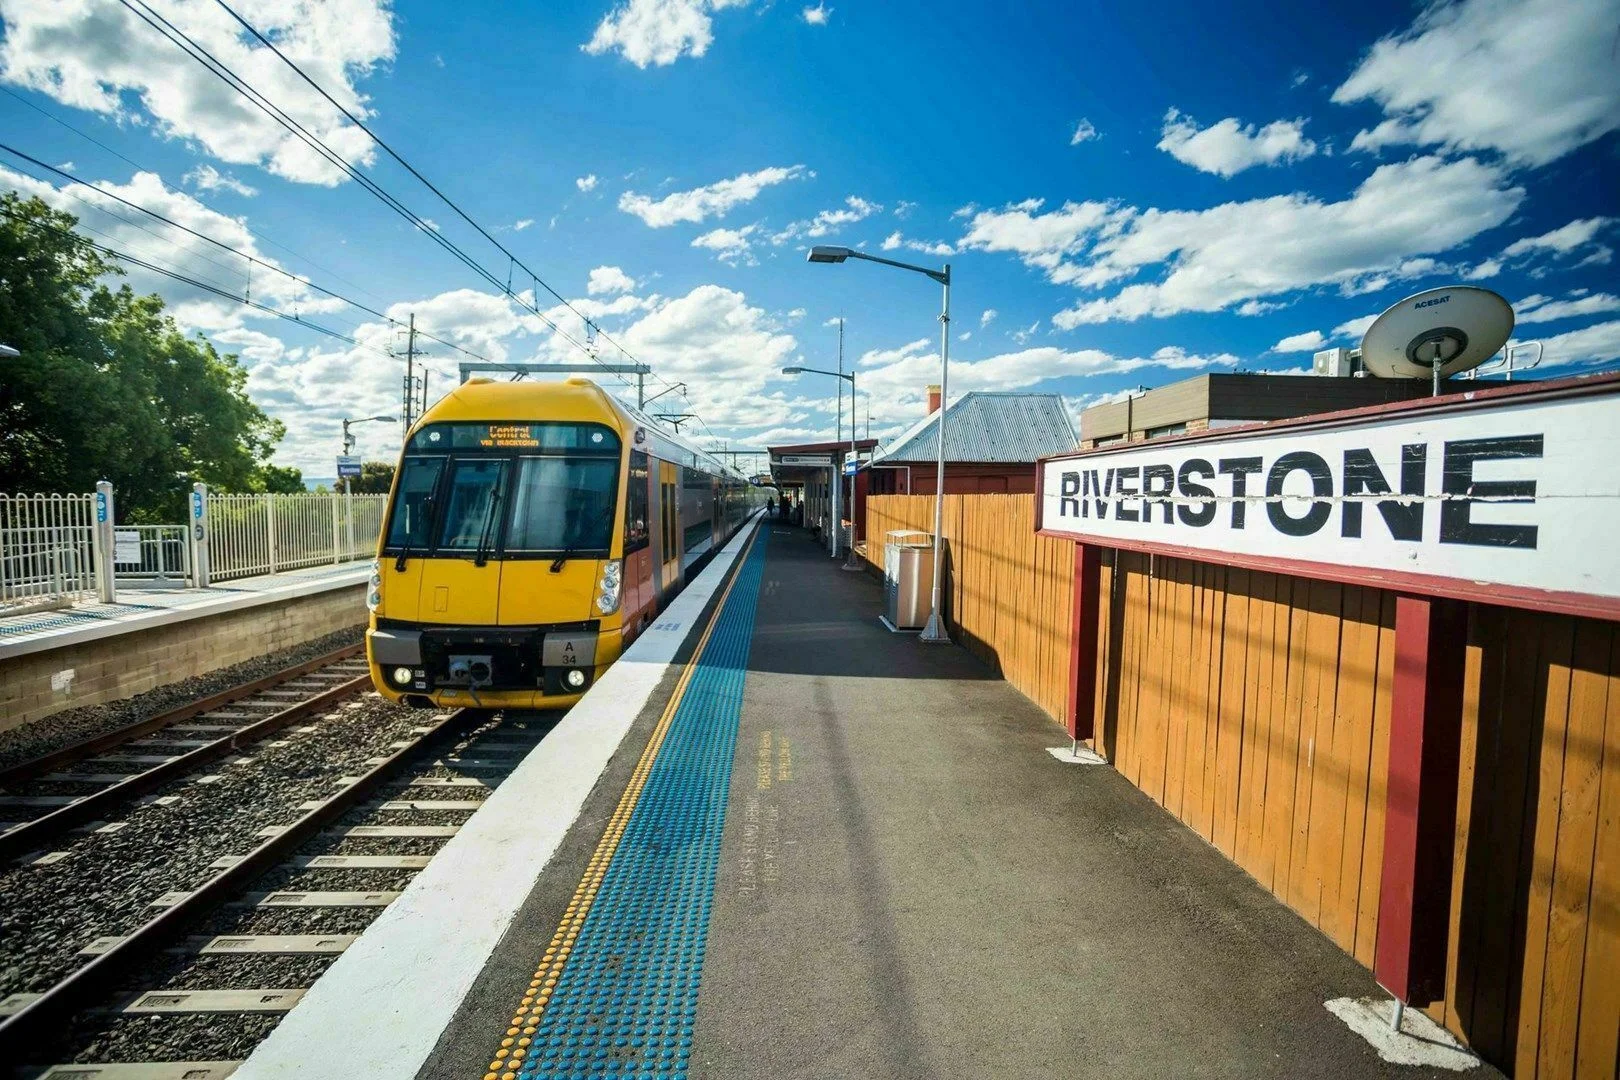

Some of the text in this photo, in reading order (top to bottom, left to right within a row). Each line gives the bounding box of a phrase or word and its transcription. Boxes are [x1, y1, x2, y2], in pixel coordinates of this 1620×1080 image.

[1414, 295, 1451, 310] ACESAT
[489, 425, 531, 439] Central
[1059, 432, 1544, 551] RIVERSTONE
[565, 641, 574, 652] A
[562, 654, 576, 665] 34
